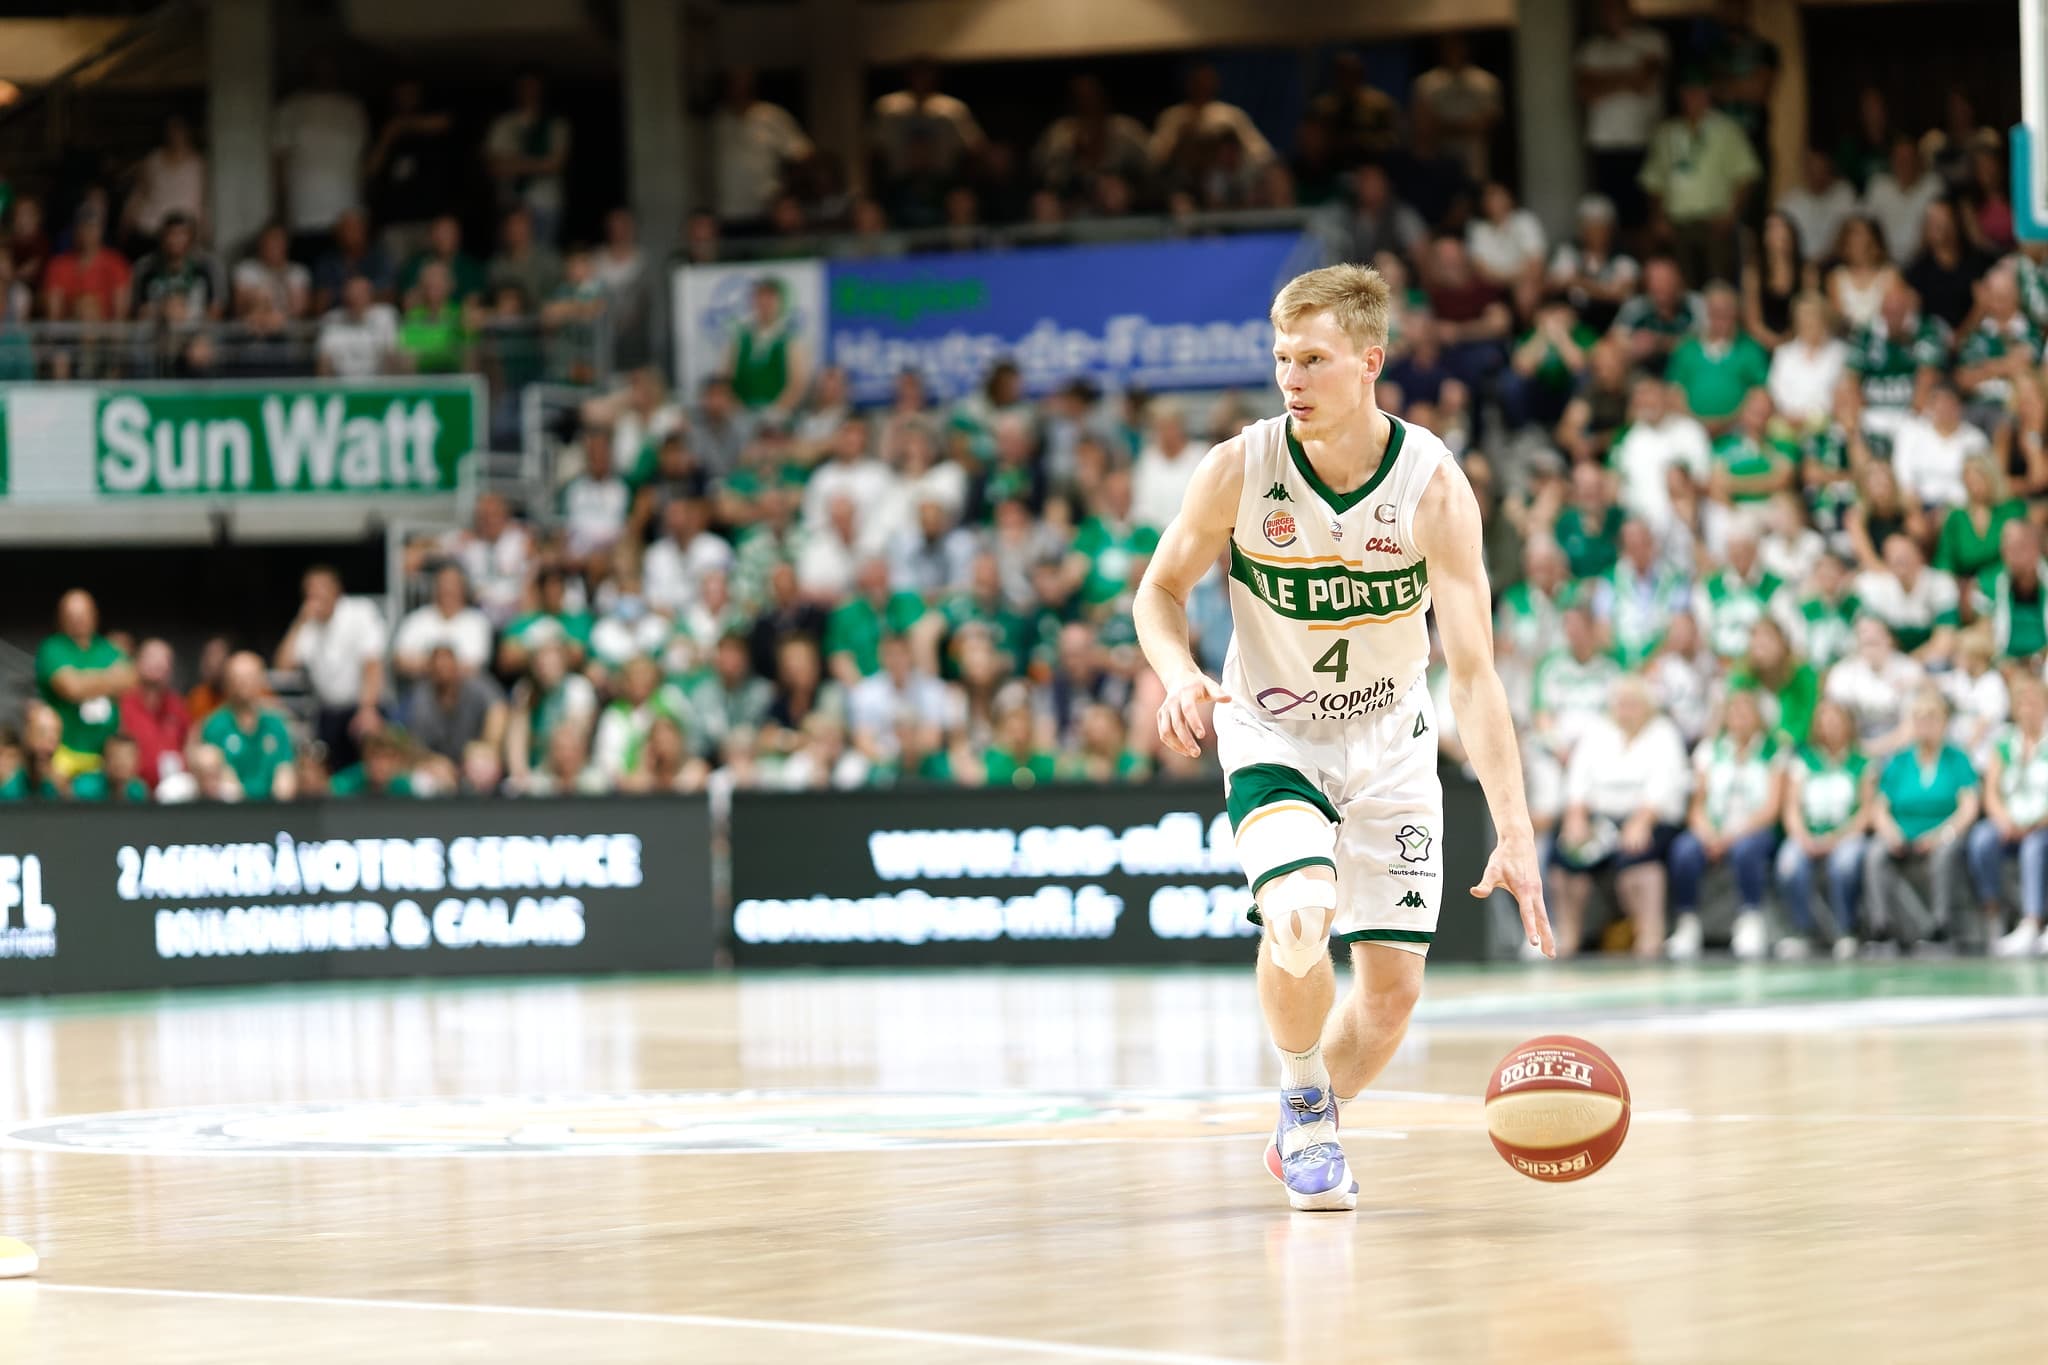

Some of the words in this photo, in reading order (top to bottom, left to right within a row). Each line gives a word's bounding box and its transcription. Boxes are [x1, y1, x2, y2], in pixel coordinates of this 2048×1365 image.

[101, 396, 252, 490] Sun
[261, 394, 439, 488] Watt
[1267, 517, 1294, 528] BURGER
[1268, 524, 1295, 537] KING
[1261, 573, 1297, 611] LE
[1308, 571, 1423, 612] PORTEL
[1312, 638, 1349, 682] 4
[1320, 677, 1395, 711] copalis
[298, 837, 446, 894] VOTRE
[449, 833, 643, 889] SERVICE
[1517, 1155, 1586, 1176] Betclic
